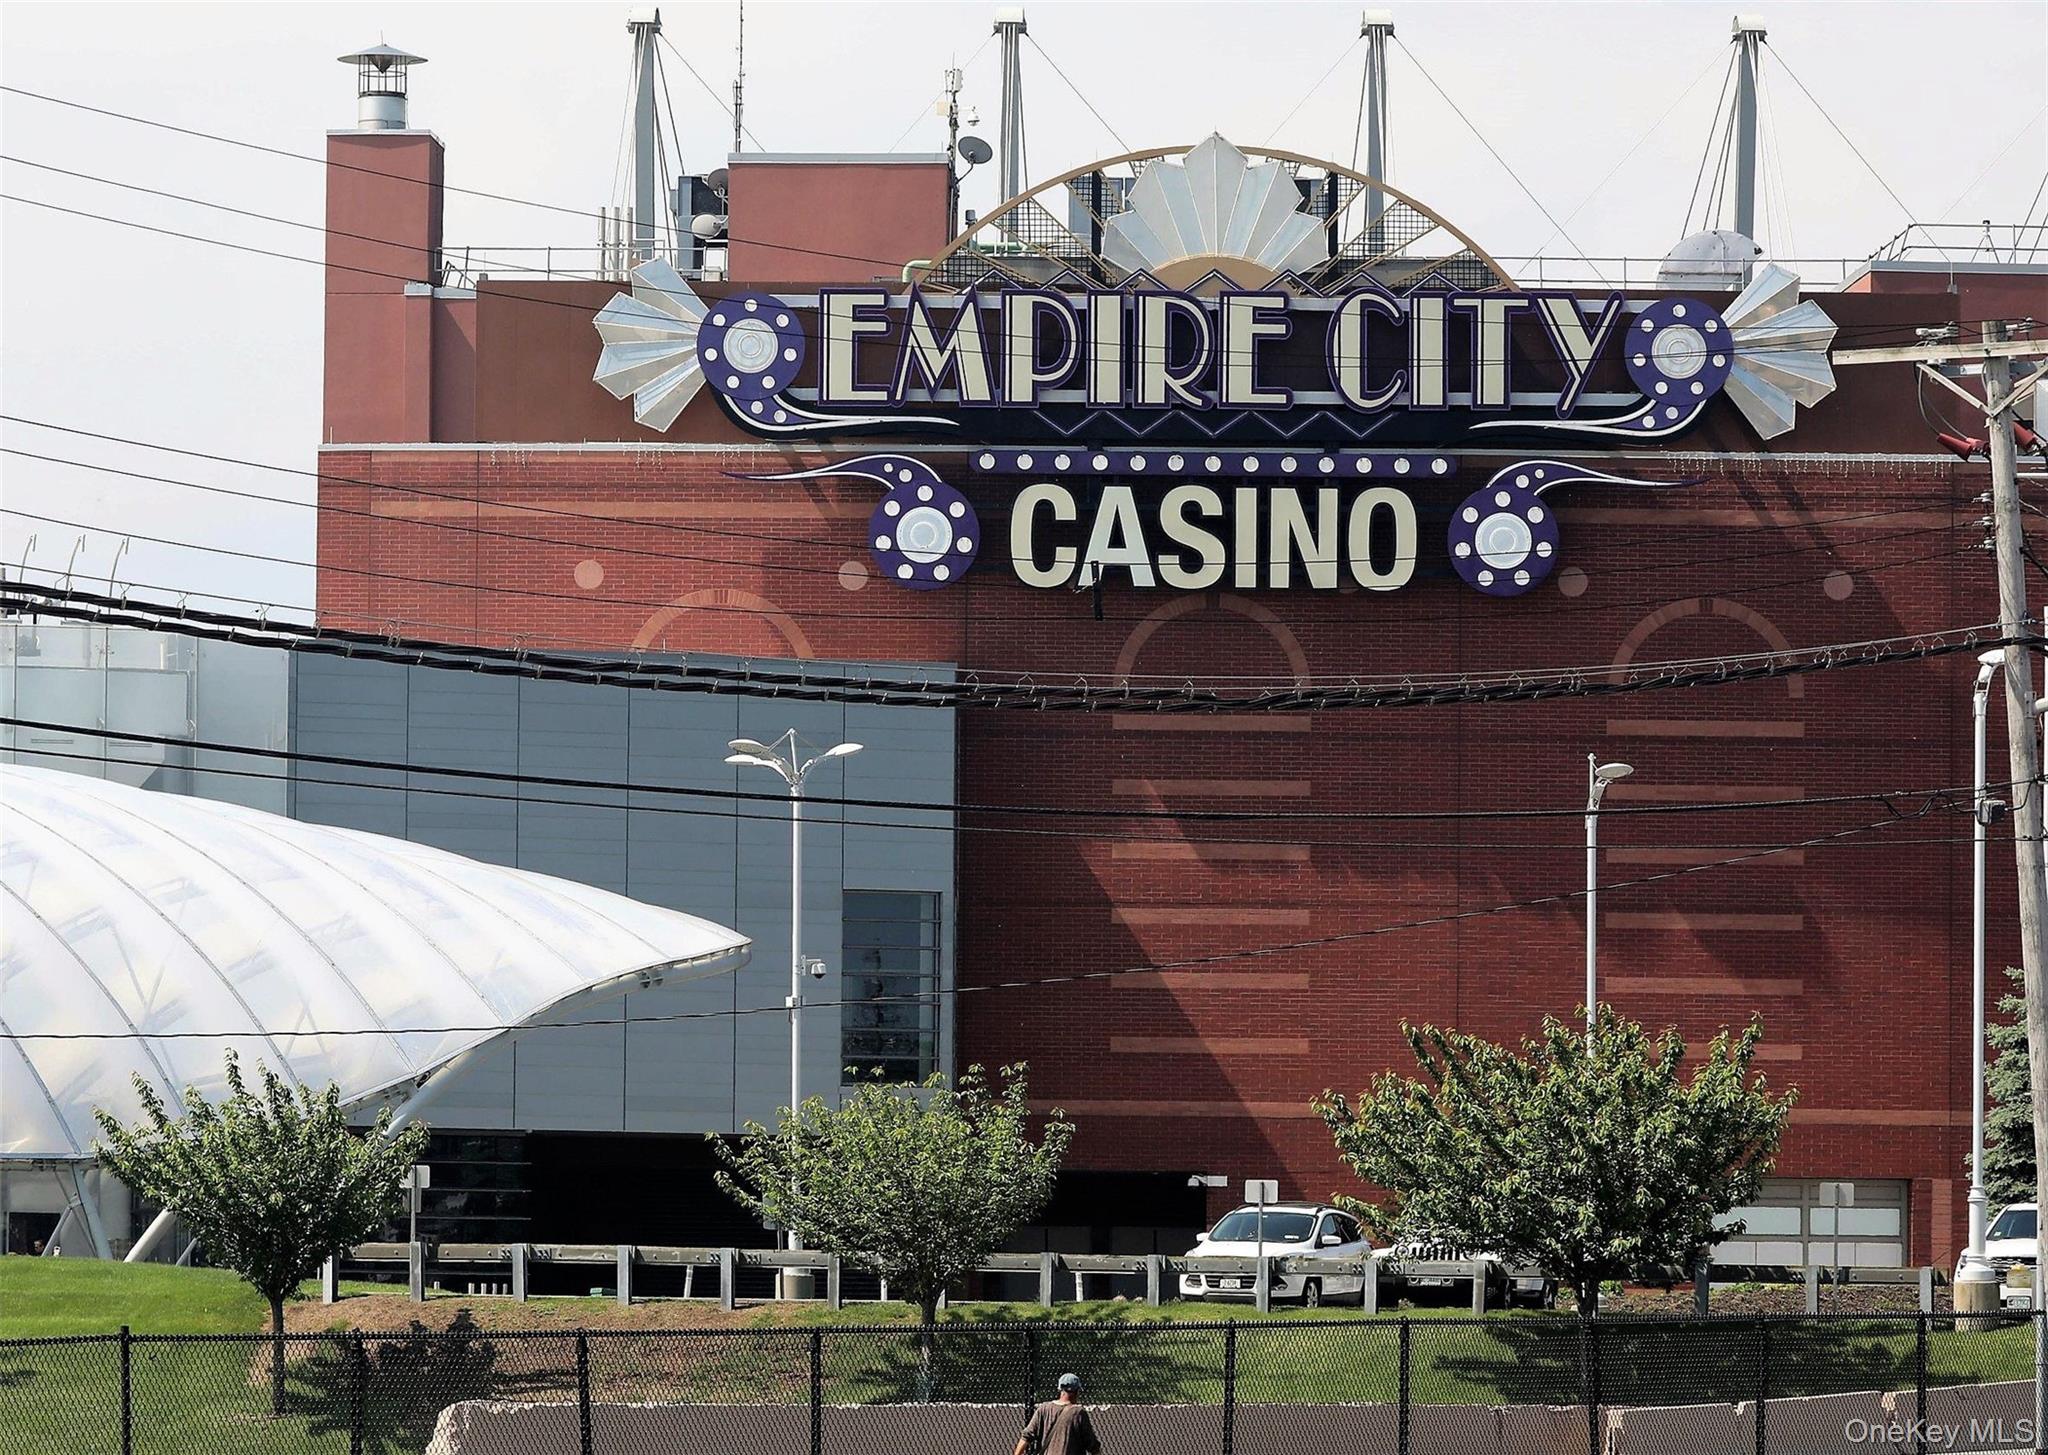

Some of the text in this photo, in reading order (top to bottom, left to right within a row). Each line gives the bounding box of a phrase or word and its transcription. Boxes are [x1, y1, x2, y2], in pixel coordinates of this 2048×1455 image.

[820, 286, 1622, 415] EMPIRE CITY
[1010, 483, 1418, 592] CASINO
